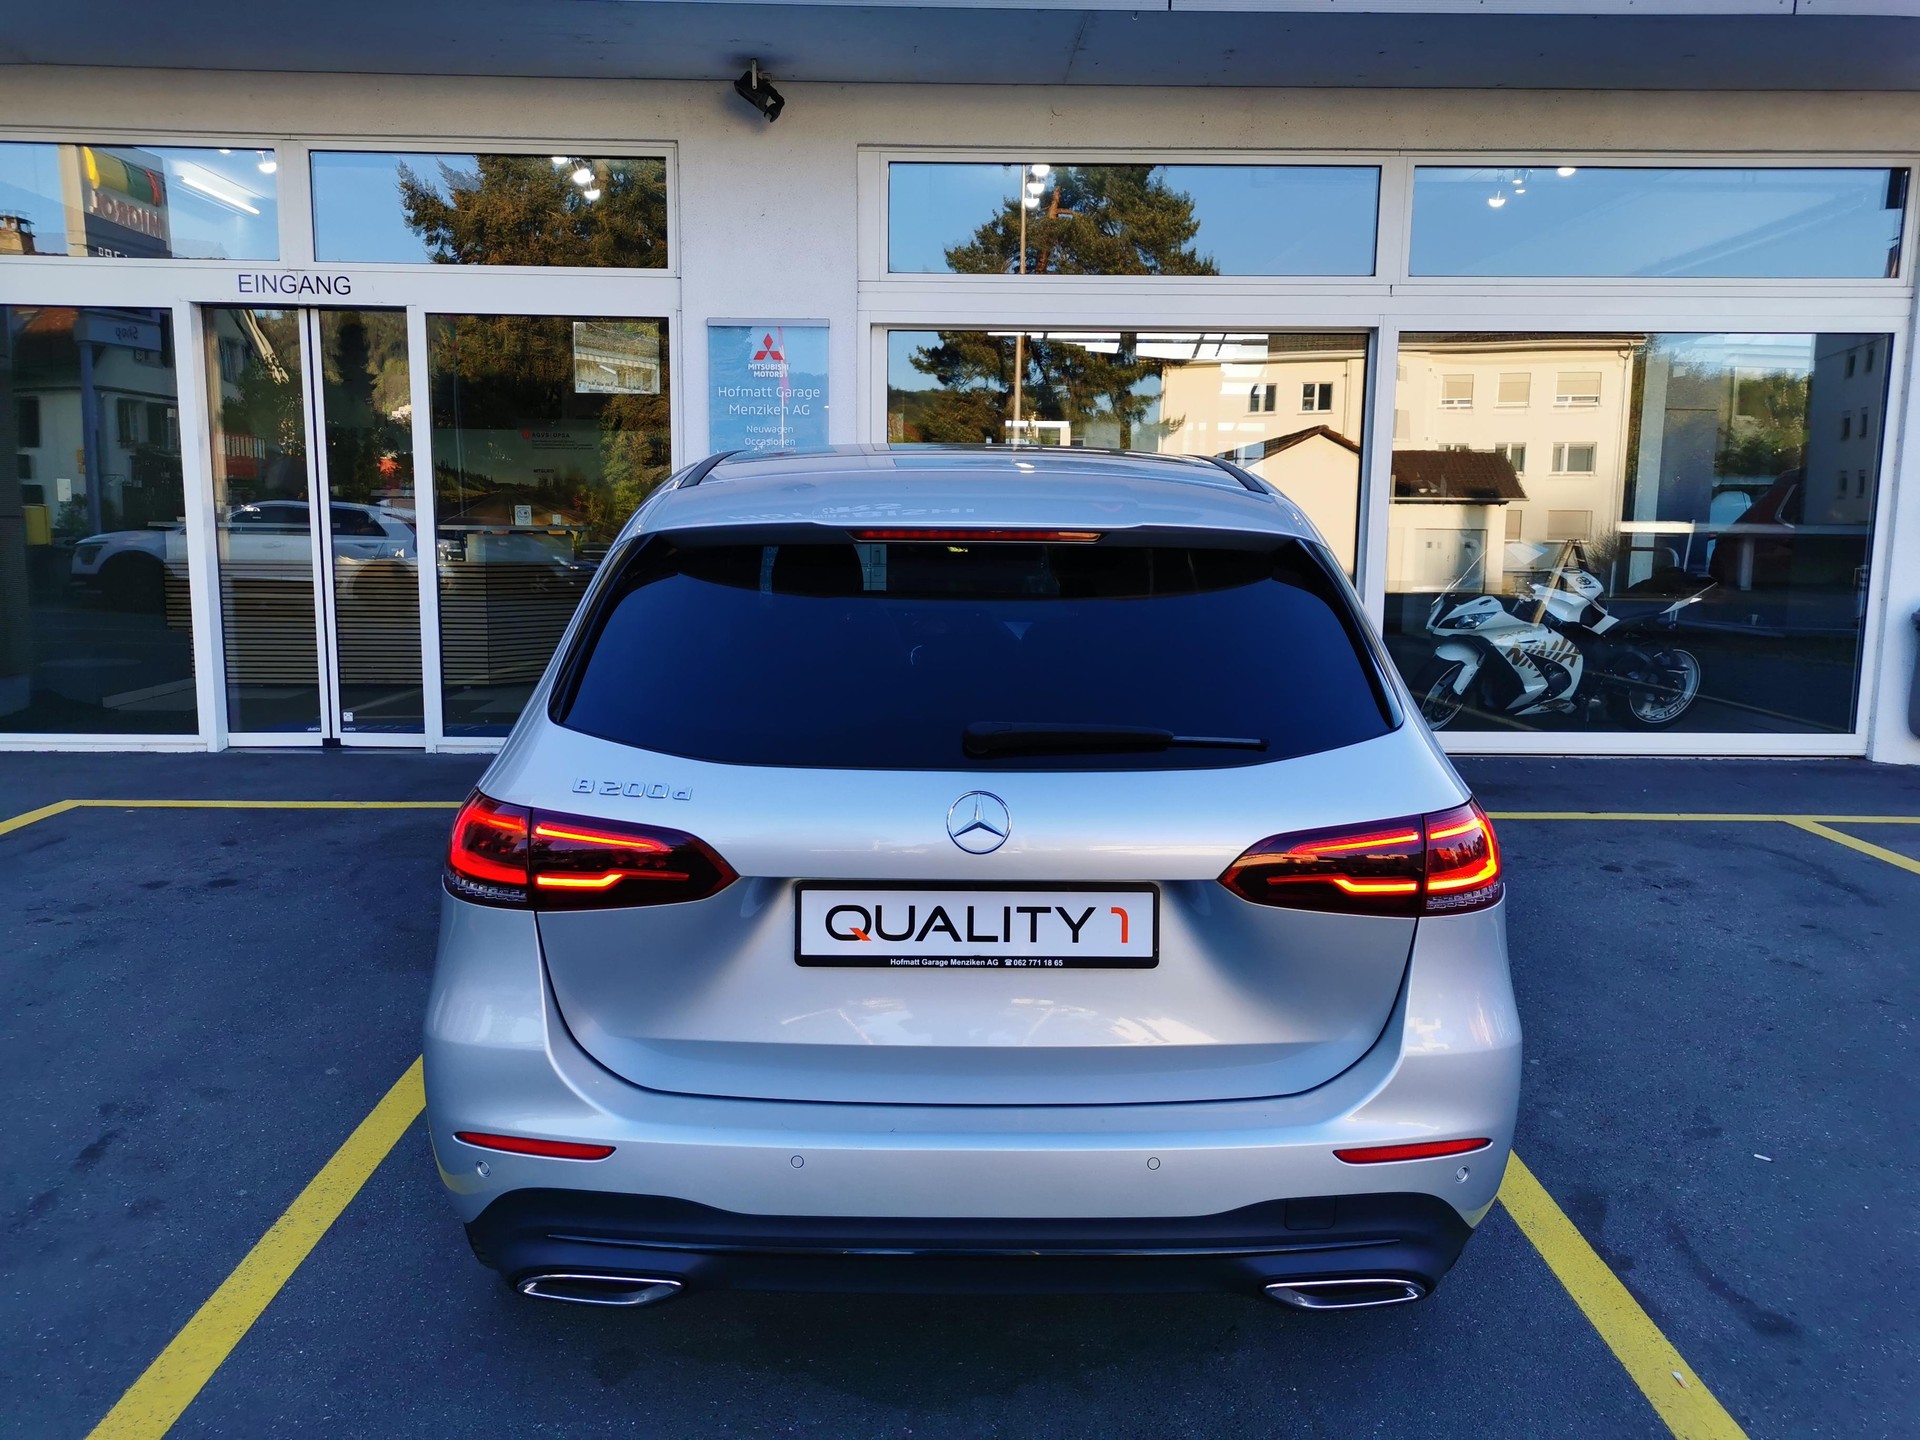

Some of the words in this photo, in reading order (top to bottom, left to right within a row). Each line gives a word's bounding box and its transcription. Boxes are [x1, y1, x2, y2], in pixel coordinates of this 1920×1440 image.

[238, 274, 352, 295] EINGANG
[748, 363, 790, 371] MITSUBISHI
[753, 370, 784, 378] MOTORS
[718, 386, 773, 398] Hofmatt
[776, 387, 820, 400] Garage
[729, 404, 789, 416] Menziken
[792, 404, 811, 416] AG
[746, 425, 794, 435] Neuwagen
[744, 437, 796, 446] Occasionen
[825, 904, 1097, 944] QUALITY
[1111, 907, 1129, 944] 1
[890, 958, 920, 966] Hofmatt
[921, 958, 949, 967] Garage
[950, 958, 986, 966] Menziken
[1013, 959, 1027, 967] 062
[1028, 959, 1041, 967] 771
[1043, 959, 1053, 967] 18
[1054, 959, 1063, 967] 65
